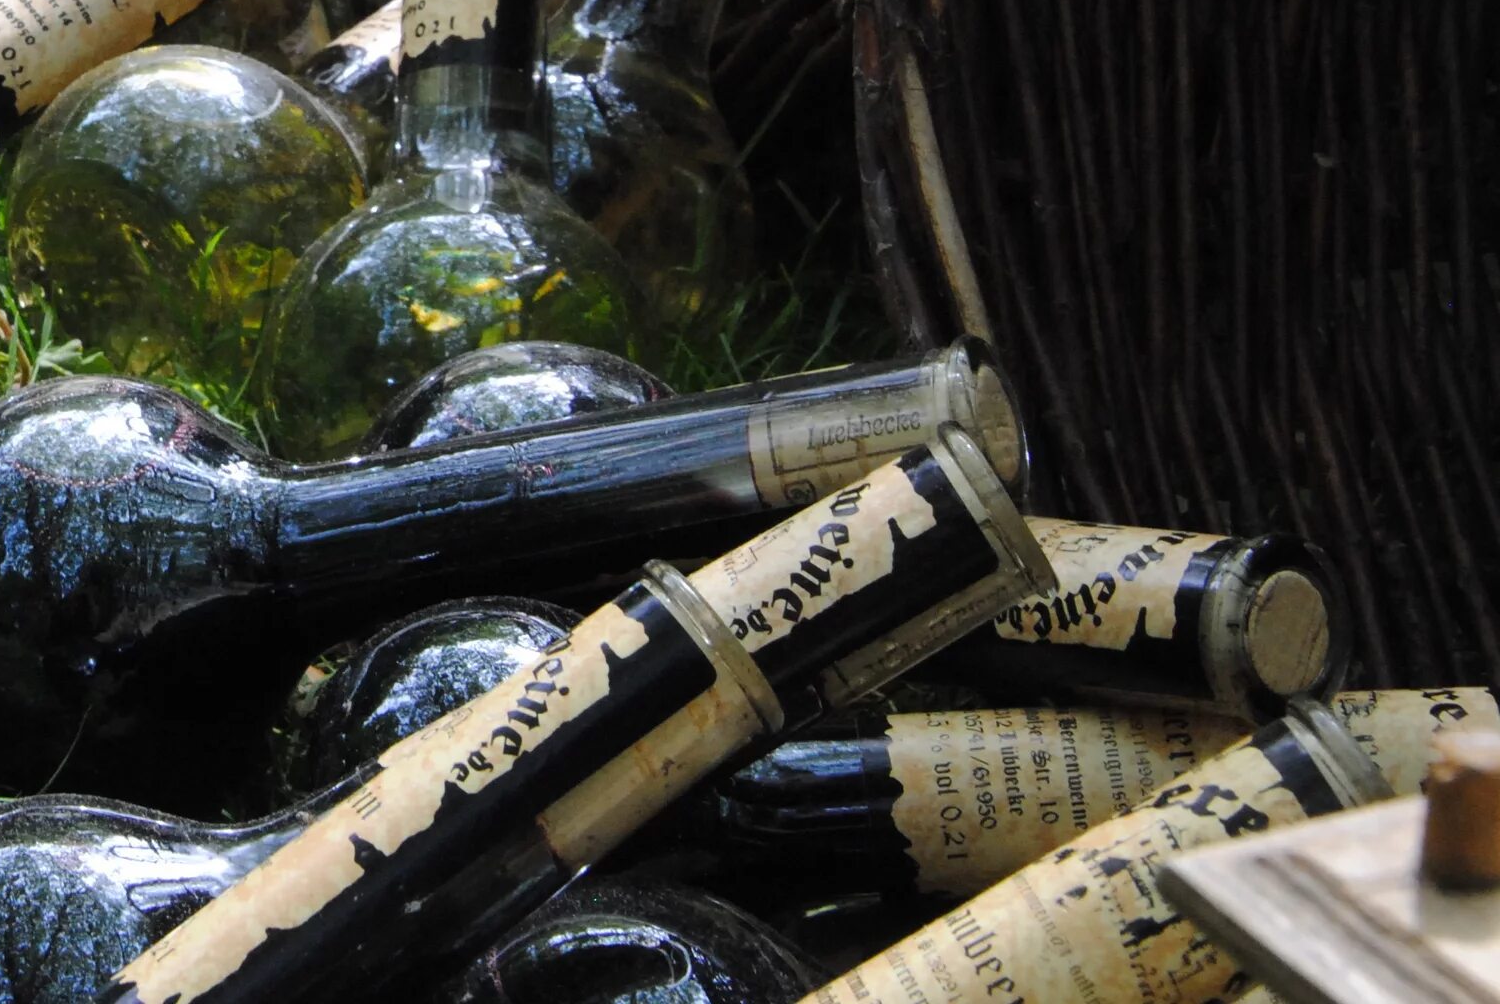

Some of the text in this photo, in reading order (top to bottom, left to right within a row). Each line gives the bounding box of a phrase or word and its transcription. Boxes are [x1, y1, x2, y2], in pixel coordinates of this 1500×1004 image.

[56, 10, 74, 28] 14
[934, 761, 959, 796] vol
[1038, 800, 1060, 825] 10
